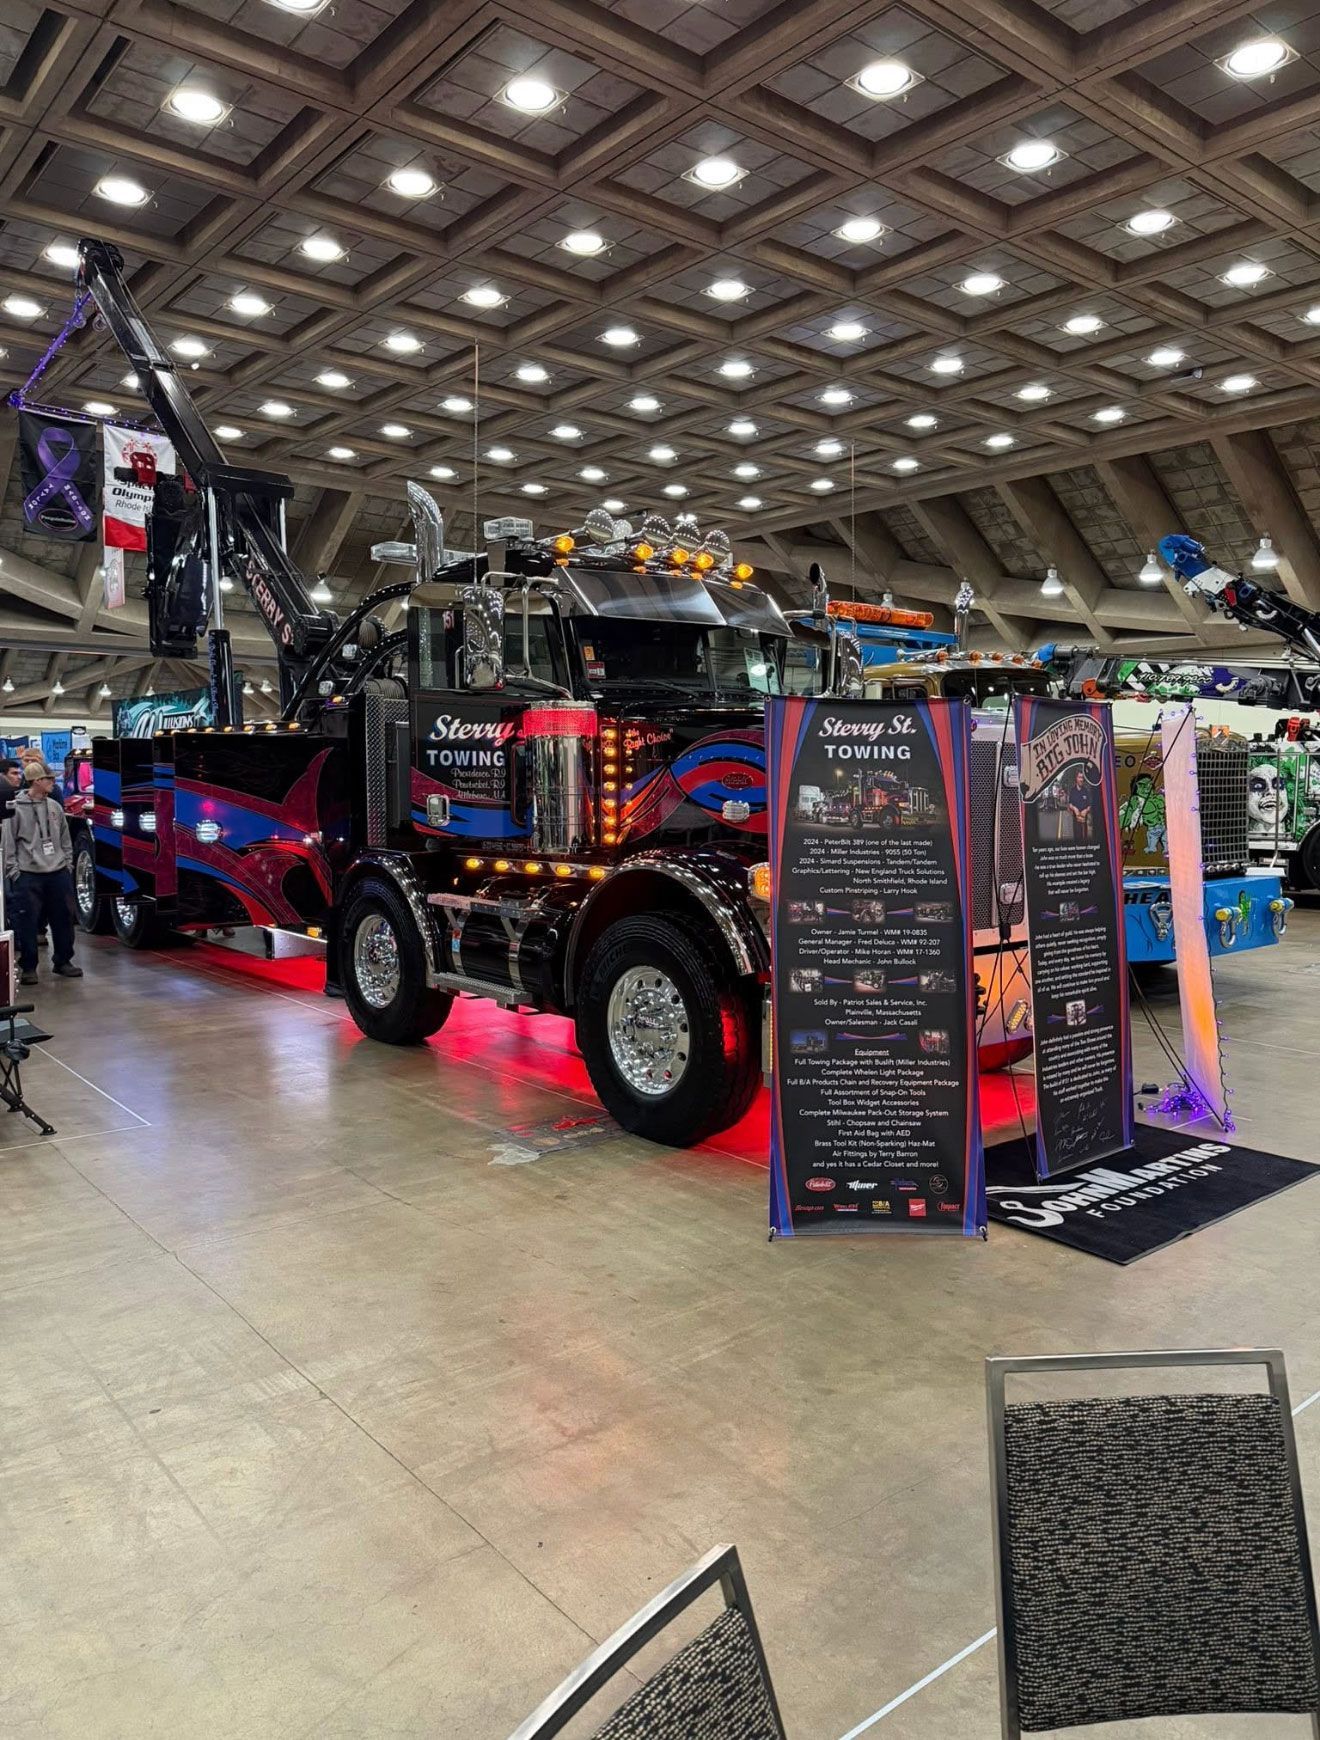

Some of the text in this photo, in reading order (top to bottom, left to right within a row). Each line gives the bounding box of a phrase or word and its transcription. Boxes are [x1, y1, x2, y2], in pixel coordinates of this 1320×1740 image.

[112, 488, 152, 502] Olymp
[429, 714, 515, 748] Sterry
[818, 714, 917, 742] Sterry St.
[1046, 720, 1074, 748] LOVING
[1074, 718, 1103, 739] MEMORY
[1064, 732, 1098, 759] JOHN
[824, 745, 911, 760] TOWING
[426, 750, 505, 766] TOWING
[913, 839, 932, 848] made)
[843, 858, 880, 866] Suspensions
[886, 858, 936, 866] Tandem/Tandem
[871, 868, 896, 876] England
[845, 887, 878, 895] Pinstriping
[883, 887, 899, 895] Larry
[824, 938, 851, 947] Manager
[799, 948, 848, 957] Driver/Operator
[824, 1018, 877, 1027] Owner/Salesman
[854, 1049, 888, 1057] Equipment
[808, 1058, 830, 1067] Towing
[832, 1058, 857, 1067] Package
[895, 1058, 915, 1067] (Miller
[917, 1058, 950, 1067] Industries)
[821, 1068, 852, 1077] Complete
[879, 1069, 895, 1077] Light
[897, 1069, 923, 1077] Package
[871, 1079, 898, 1087] Recovery
[900, 1079, 932, 1087] Equipment
[933, 1079, 958, 1088] Package
[880, 1089, 907, 1097] Snap-On
[856, 1099, 879, 1107] Widget
[799, 1109, 830, 1117] Complete
[898, 1109, 923, 1118] Storage
[925, 1109, 948, 1118] System
[846, 1119, 875, 1128] Chopsaw
[866, 1129, 878, 1138] Bag
[858, 1139, 906, 1148] (Non-Sparking)
[843, 1150, 867, 1158] Fittings
[878, 1150, 894, 1158] Terry
[1086, 1163, 1222, 1218] FOUNDATION
